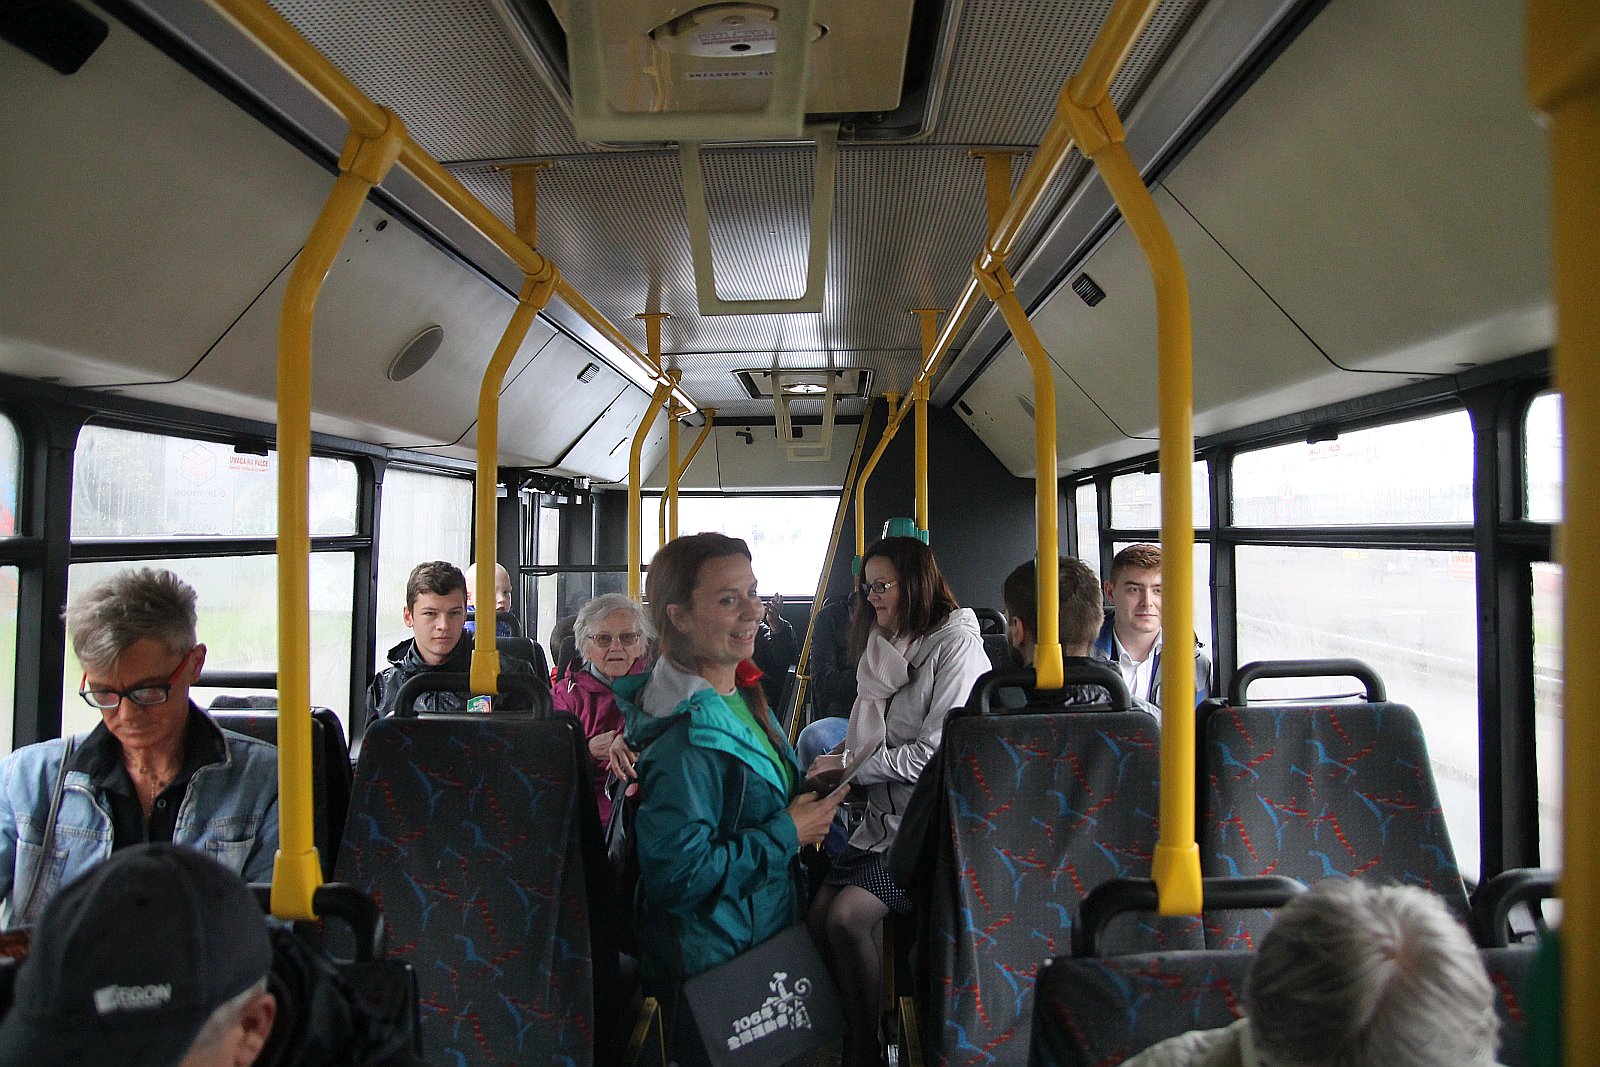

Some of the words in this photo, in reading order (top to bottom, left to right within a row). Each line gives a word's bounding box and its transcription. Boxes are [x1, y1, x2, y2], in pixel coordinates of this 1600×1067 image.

[229, 456, 247, 466] UWAGA
[255, 459, 269, 468] PALCE
[1451, 554, 1474, 564] UWAGA
